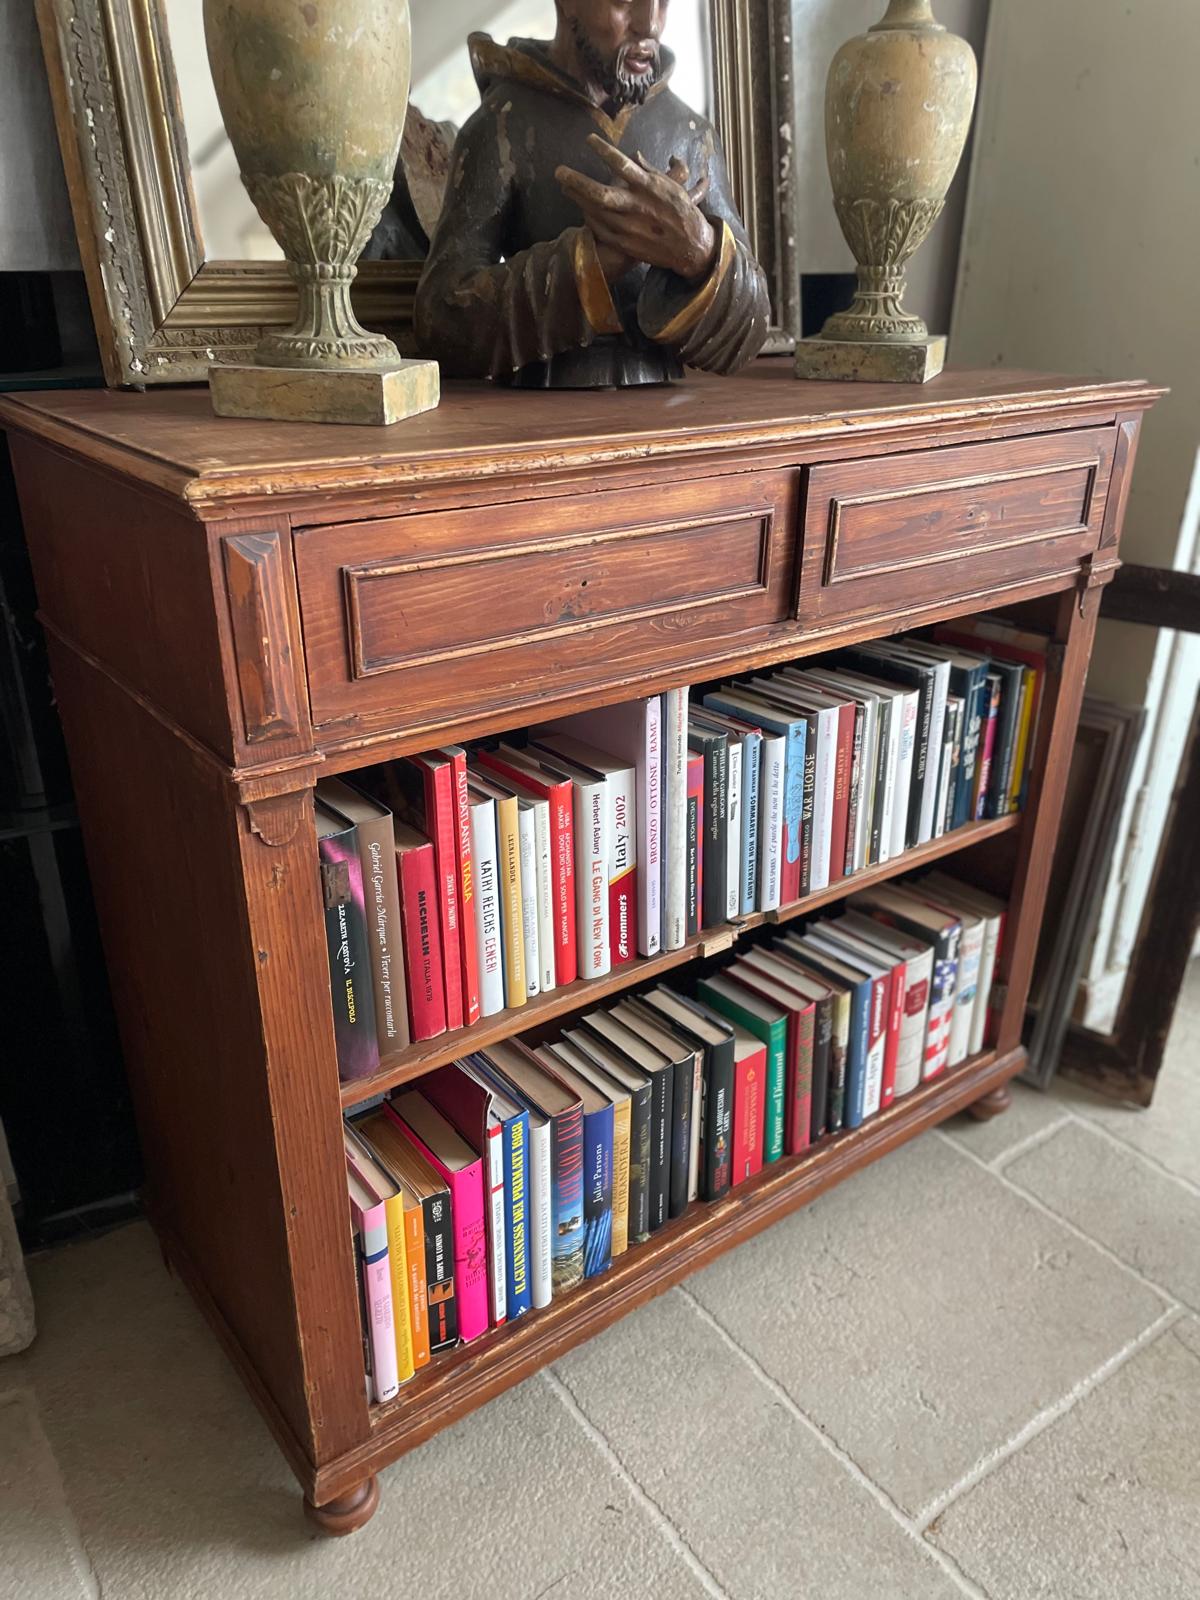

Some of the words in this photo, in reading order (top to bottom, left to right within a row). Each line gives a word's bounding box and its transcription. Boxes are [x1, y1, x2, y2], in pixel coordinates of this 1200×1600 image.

[649, 719, 658, 753] RAME
[712, 750, 720, 779] L'amante
[719, 748, 727, 782] PHILIPPA
[772, 761, 780, 779] detto
[804, 753, 816, 793] HORSE
[836, 747, 845, 775] MEYER
[649, 762, 659, 809] OTTONE
[772, 780, 779, 789] ho
[835, 777, 843, 800] DEON
[591, 794, 602, 825] Herbert
[615, 795, 626, 829] 2002
[689, 802, 697, 823] EVELYN
[710, 797, 718, 817] regina
[719, 783, 727, 818] GREGORY
[771, 796, 779, 810] non
[802, 796, 814, 820] WAR
[710, 818, 718, 840] vergine
[748, 795, 757, 838] SOMMAREN
[770, 811, 778, 821] che
[457, 771, 471, 855] AUTOATLANTE
[464, 860, 474, 903] ITALIA
[507, 834, 515, 857] LEENA
[558, 834, 566, 852] DOVE
[591, 827, 603, 855] Asbury
[649, 819, 658, 864] BRONZO
[770, 822, 779, 844] parole
[803, 823, 811, 859] MORPURGO
[368, 843, 381, 873] Gabriel
[615, 834, 629, 868] Italy
[769, 844, 777, 854] Le
[480, 860, 494, 892] KATHY
[509, 857, 517, 884] LANDER
[592, 860, 603, 873] LE
[801, 860, 809, 888] MICHAEL
[372, 876, 385, 902] García
[446, 874, 454, 895] VENICE
[560, 885, 568, 900] SOLO
[592, 877, 604, 903] GANG
[376, 904, 388, 945] Márquez
[417, 891, 431, 956] MICHELIN
[447, 906, 456, 930] LOOKING
[482, 895, 496, 935] REICHS
[593, 918, 604, 939] NEW
[618, 894, 628, 957] Frommer's
[561, 915, 569, 946] PIANGERE
[337, 940, 355, 974] KOSTOVA
[380, 955, 392, 979] Vivere
[485, 938, 498, 974] CENERI
[594, 943, 604, 969] YORK
[346, 979, 352, 987] IL
[423, 958, 432, 984] ITALIA
[378, 981, 391, 995] per
[347, 988, 356, 1023] DISCEPOLO
[384, 996, 398, 1038] raccontarla
[873, 982, 885, 1037] Frommer's
[867, 1052, 880, 1079] Italy
[716, 1088, 725, 1126] DODICESIMA
[749, 1081, 758, 1108] DIANA
[774, 1098, 783, 1114] und
[511, 1121, 523, 1150] 1988
[716, 1126, 723, 1136] LA
[723, 1111, 731, 1133] CARTA
[748, 1108, 757, 1153] GABALDON
[770, 1116, 784, 1155] Purpur
[592, 1143, 603, 1180] Parsons
[617, 1137, 629, 1214] CURANDERA
[512, 1151, 524, 1202] PRIMATI
[540, 1162, 548, 1197] ALLENDE
[592, 1181, 604, 1204] Julie
[513, 1204, 524, 1222] DEI
[513, 1222, 526, 1281] GUINNESS
[514, 1281, 526, 1295] IL
